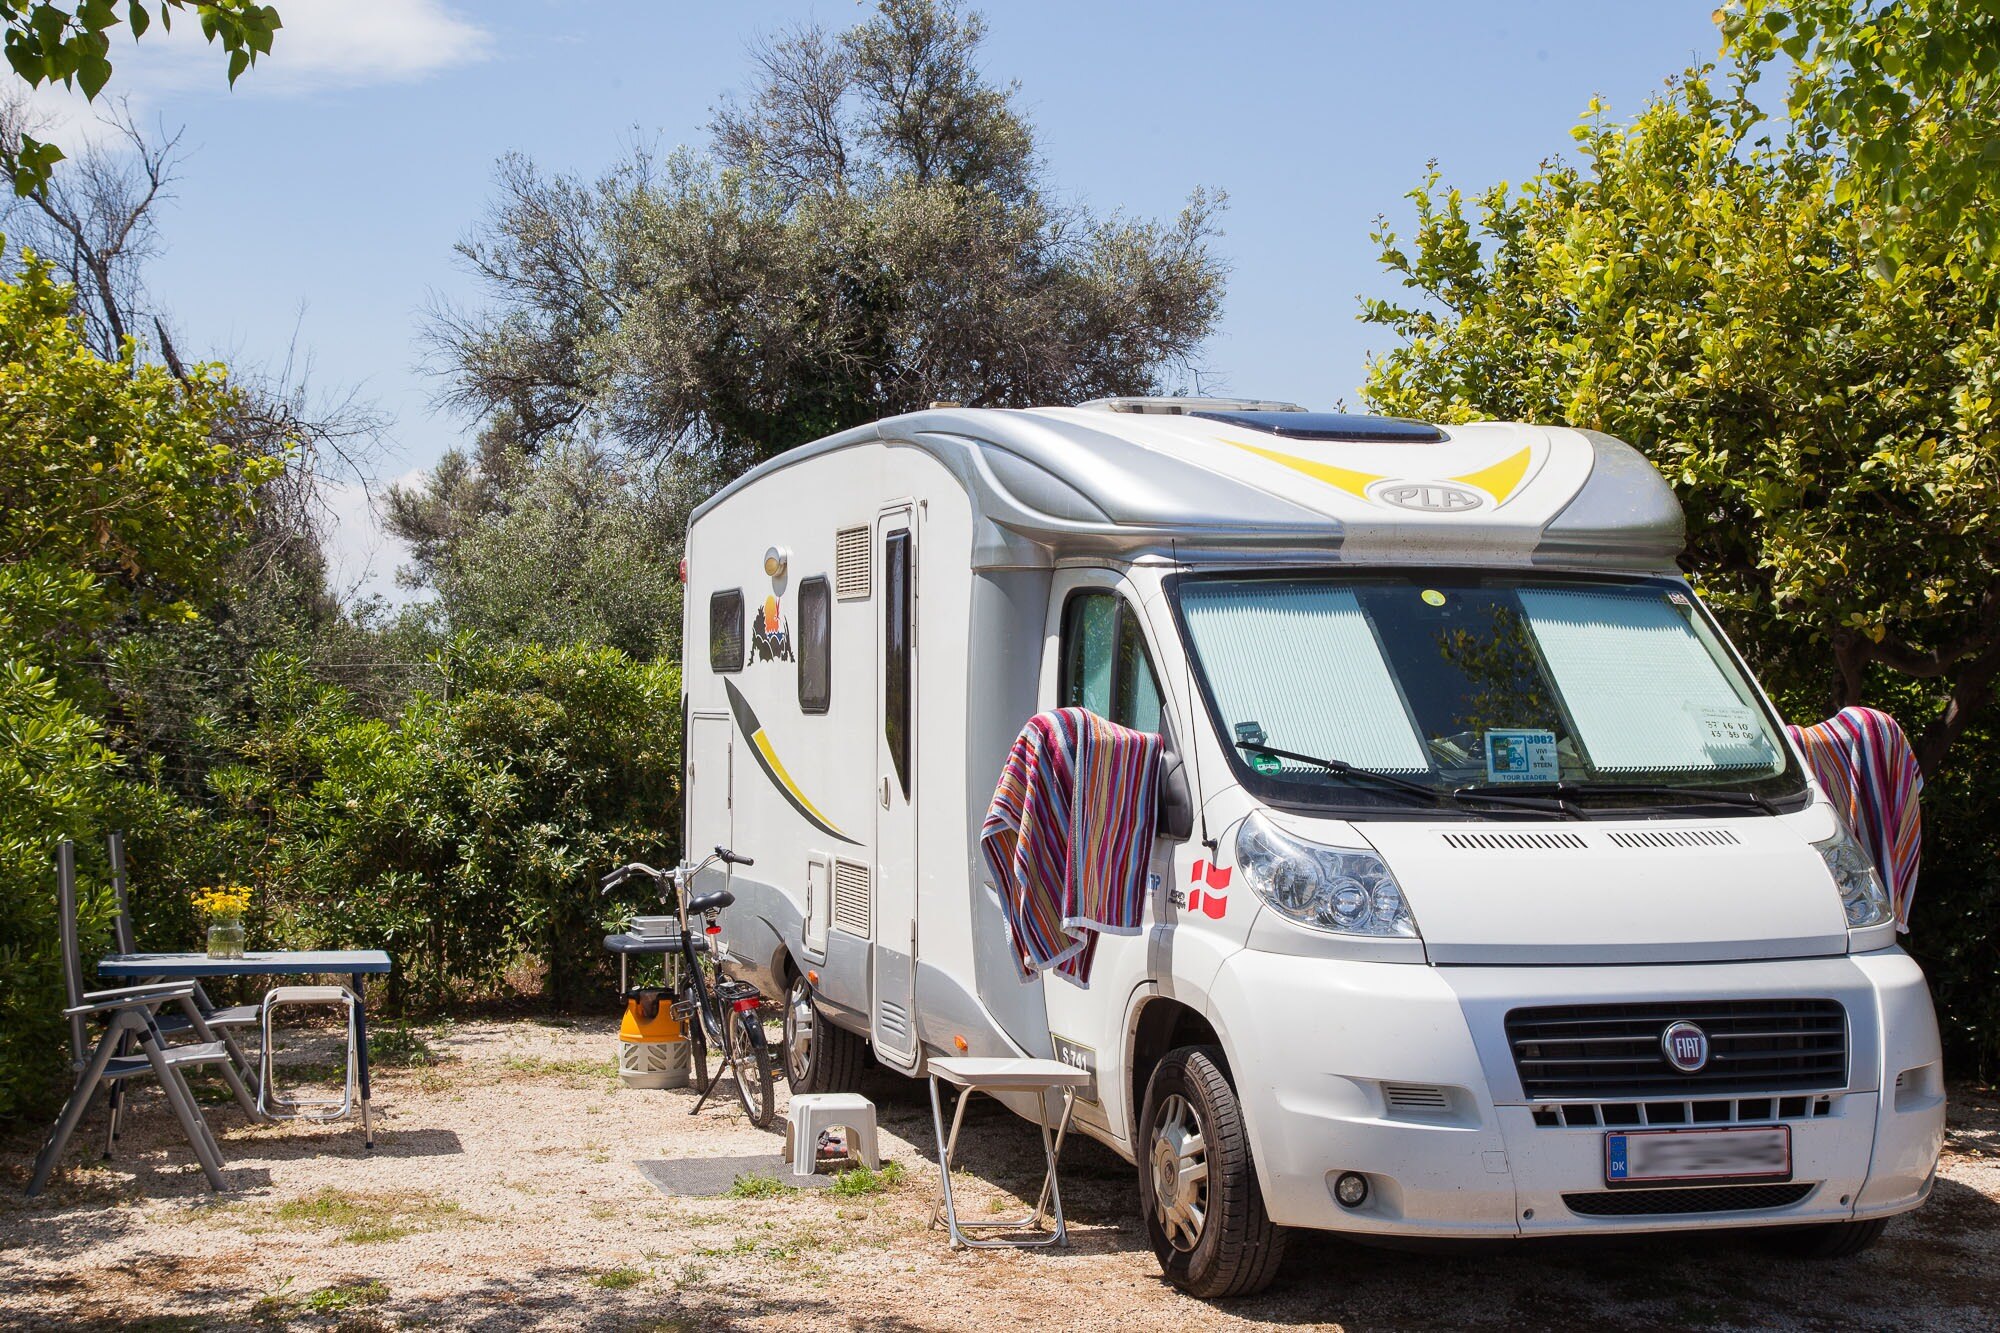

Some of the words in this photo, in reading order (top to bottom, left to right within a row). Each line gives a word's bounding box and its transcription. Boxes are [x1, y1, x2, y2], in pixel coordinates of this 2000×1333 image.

[1386, 488, 1474, 507] PLA
[1737, 722, 1748, 731] 10
[1526, 735, 1553, 744] 3082
[1675, 1037, 1699, 1058] FIAT
[1062, 1046, 1069, 1065] S
[1070, 1050, 1087, 1070] 741
[1612, 1161, 1625, 1171] DK
